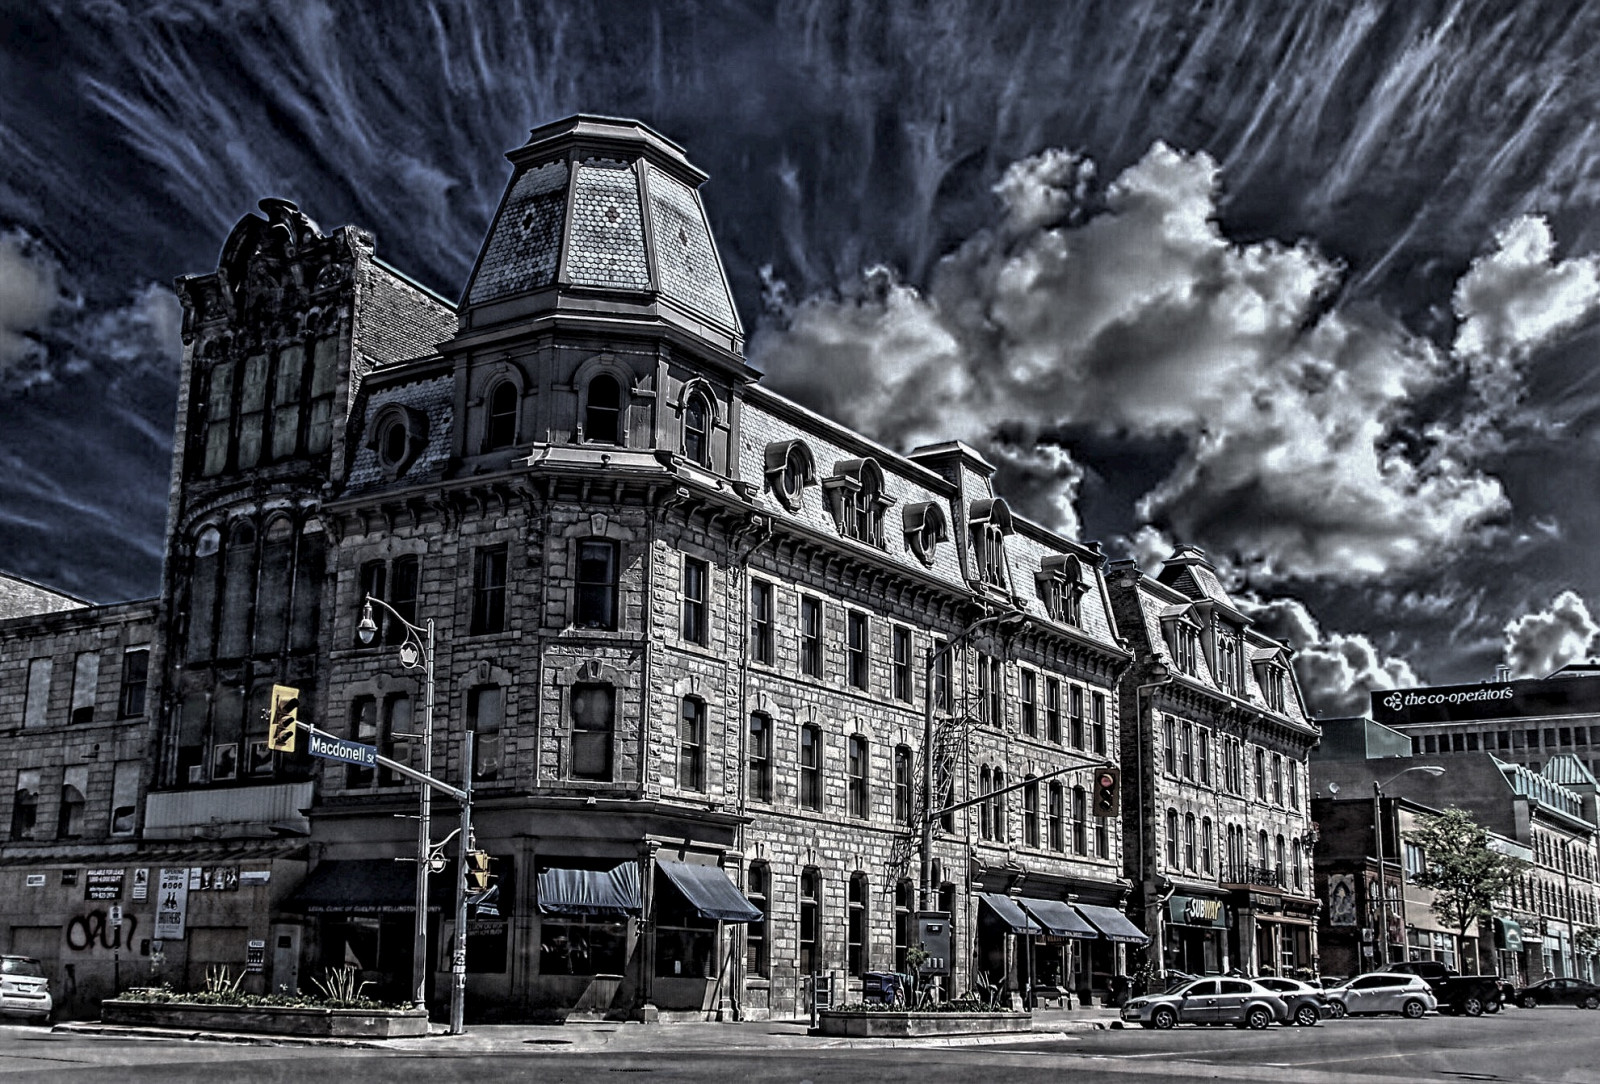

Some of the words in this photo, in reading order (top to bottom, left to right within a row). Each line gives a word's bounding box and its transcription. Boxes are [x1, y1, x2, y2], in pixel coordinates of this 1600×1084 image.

[1405, 692, 1426, 705] the
[1428, 686, 1513, 704] co-operators
[311, 737, 366, 762] Macdonell
[1189, 898, 1222, 920] SUBWAY
